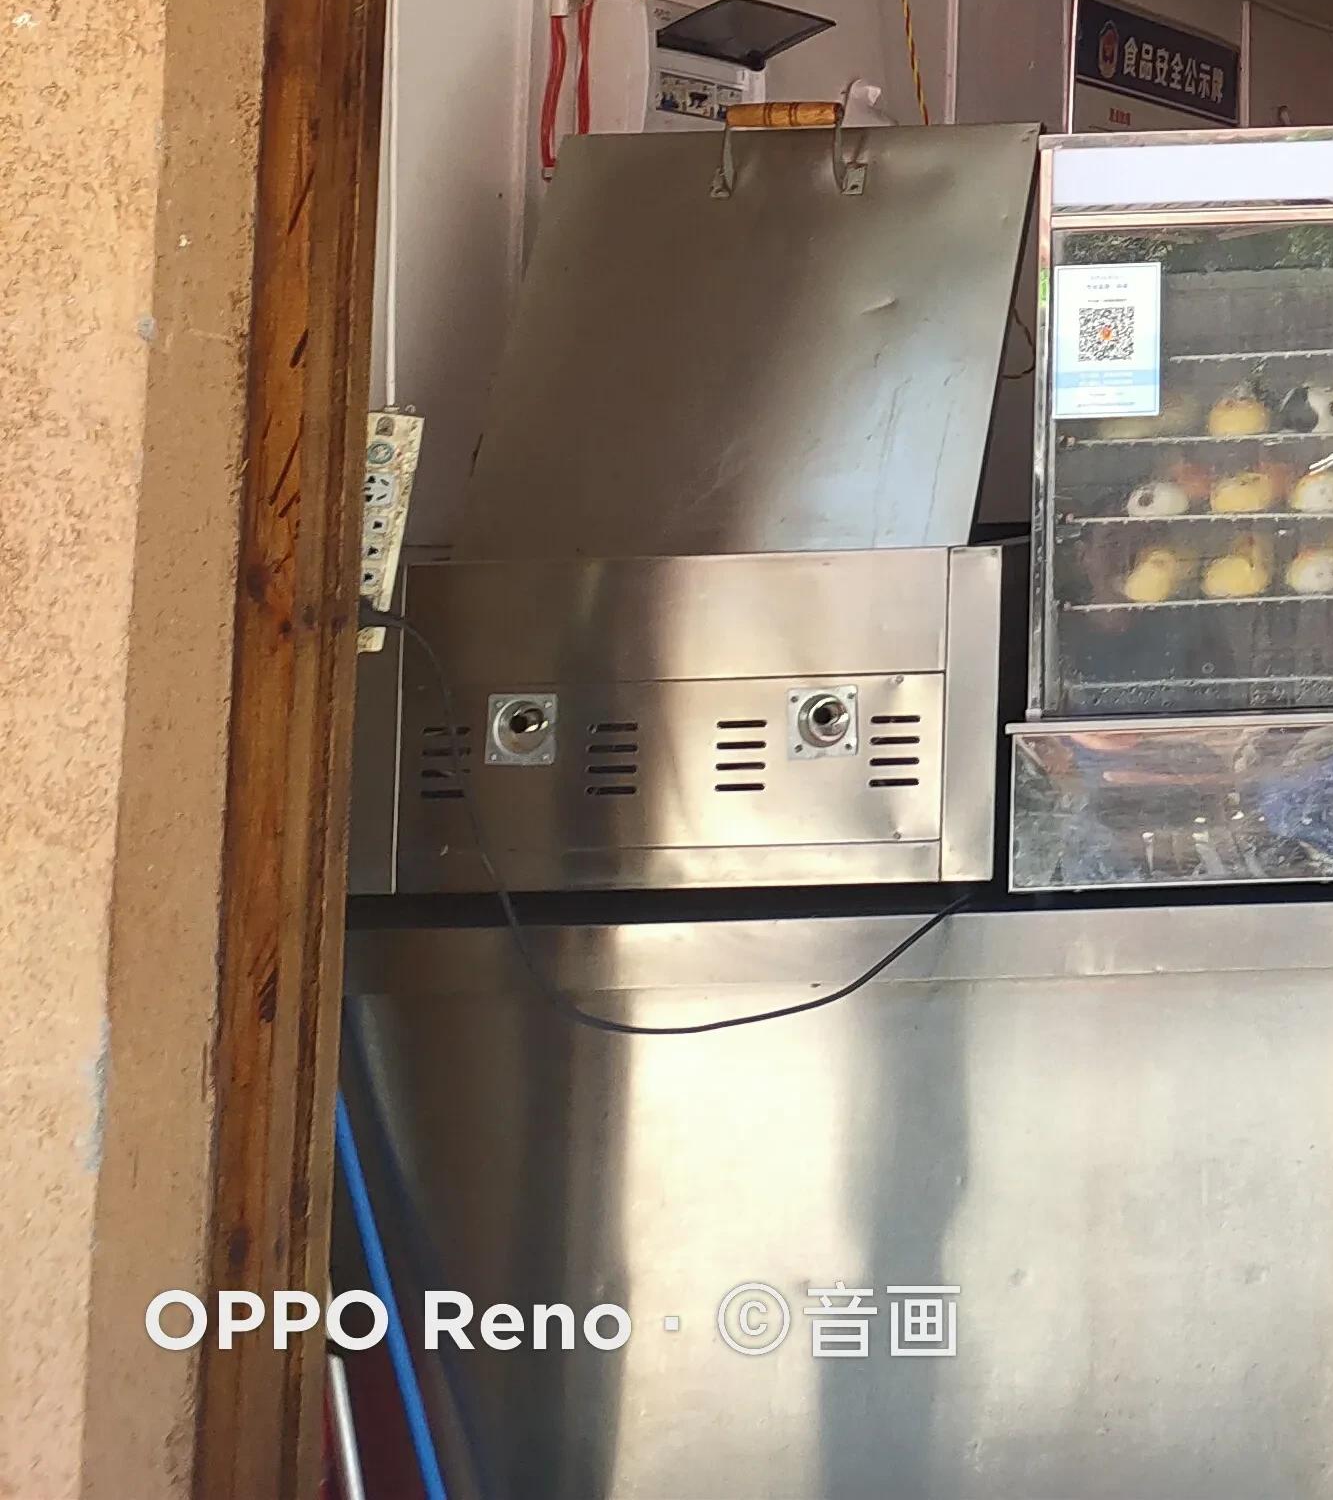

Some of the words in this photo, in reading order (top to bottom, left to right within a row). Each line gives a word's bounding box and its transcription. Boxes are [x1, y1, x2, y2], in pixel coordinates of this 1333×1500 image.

[1123, 36, 1225, 104] 食品安全公示牌
